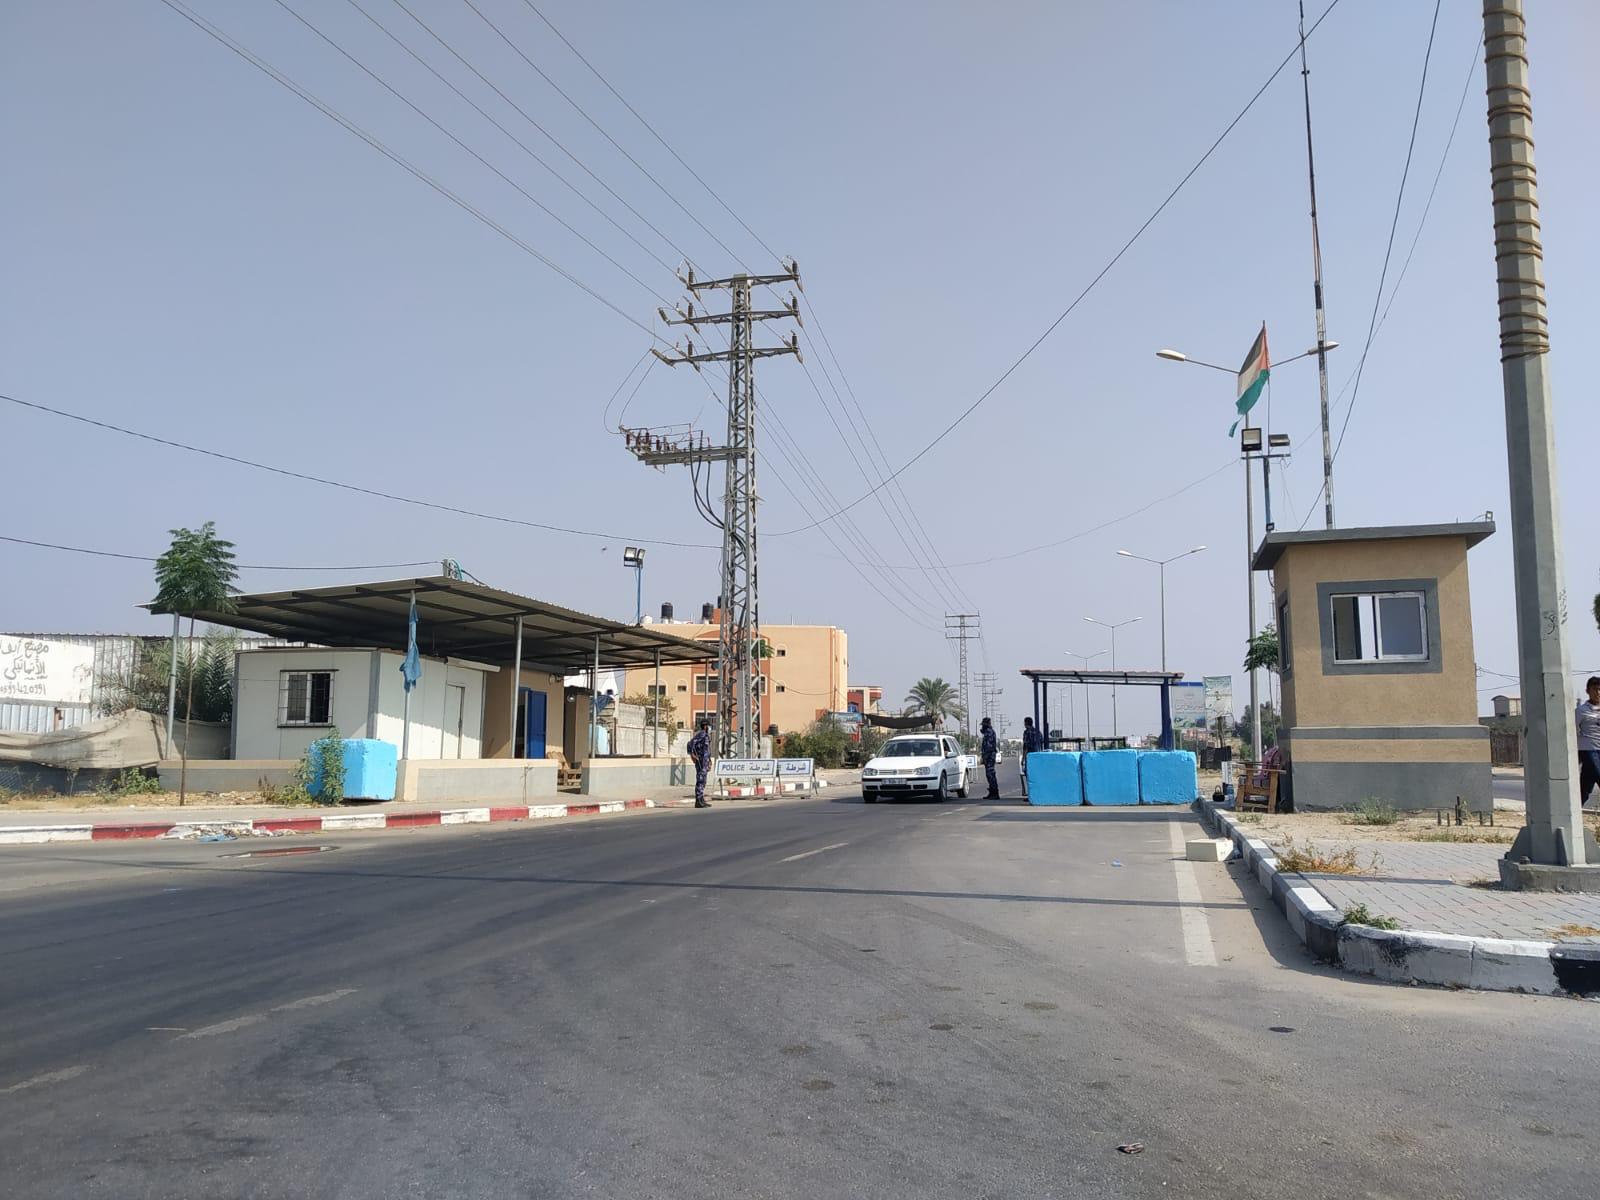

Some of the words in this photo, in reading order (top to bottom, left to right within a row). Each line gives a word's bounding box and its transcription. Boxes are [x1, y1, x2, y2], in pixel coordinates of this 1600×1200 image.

[722, 764, 745, 772] POLICE
[749, 762, 770, 773] شرطة
[786, 763, 806, 773] شرطة
